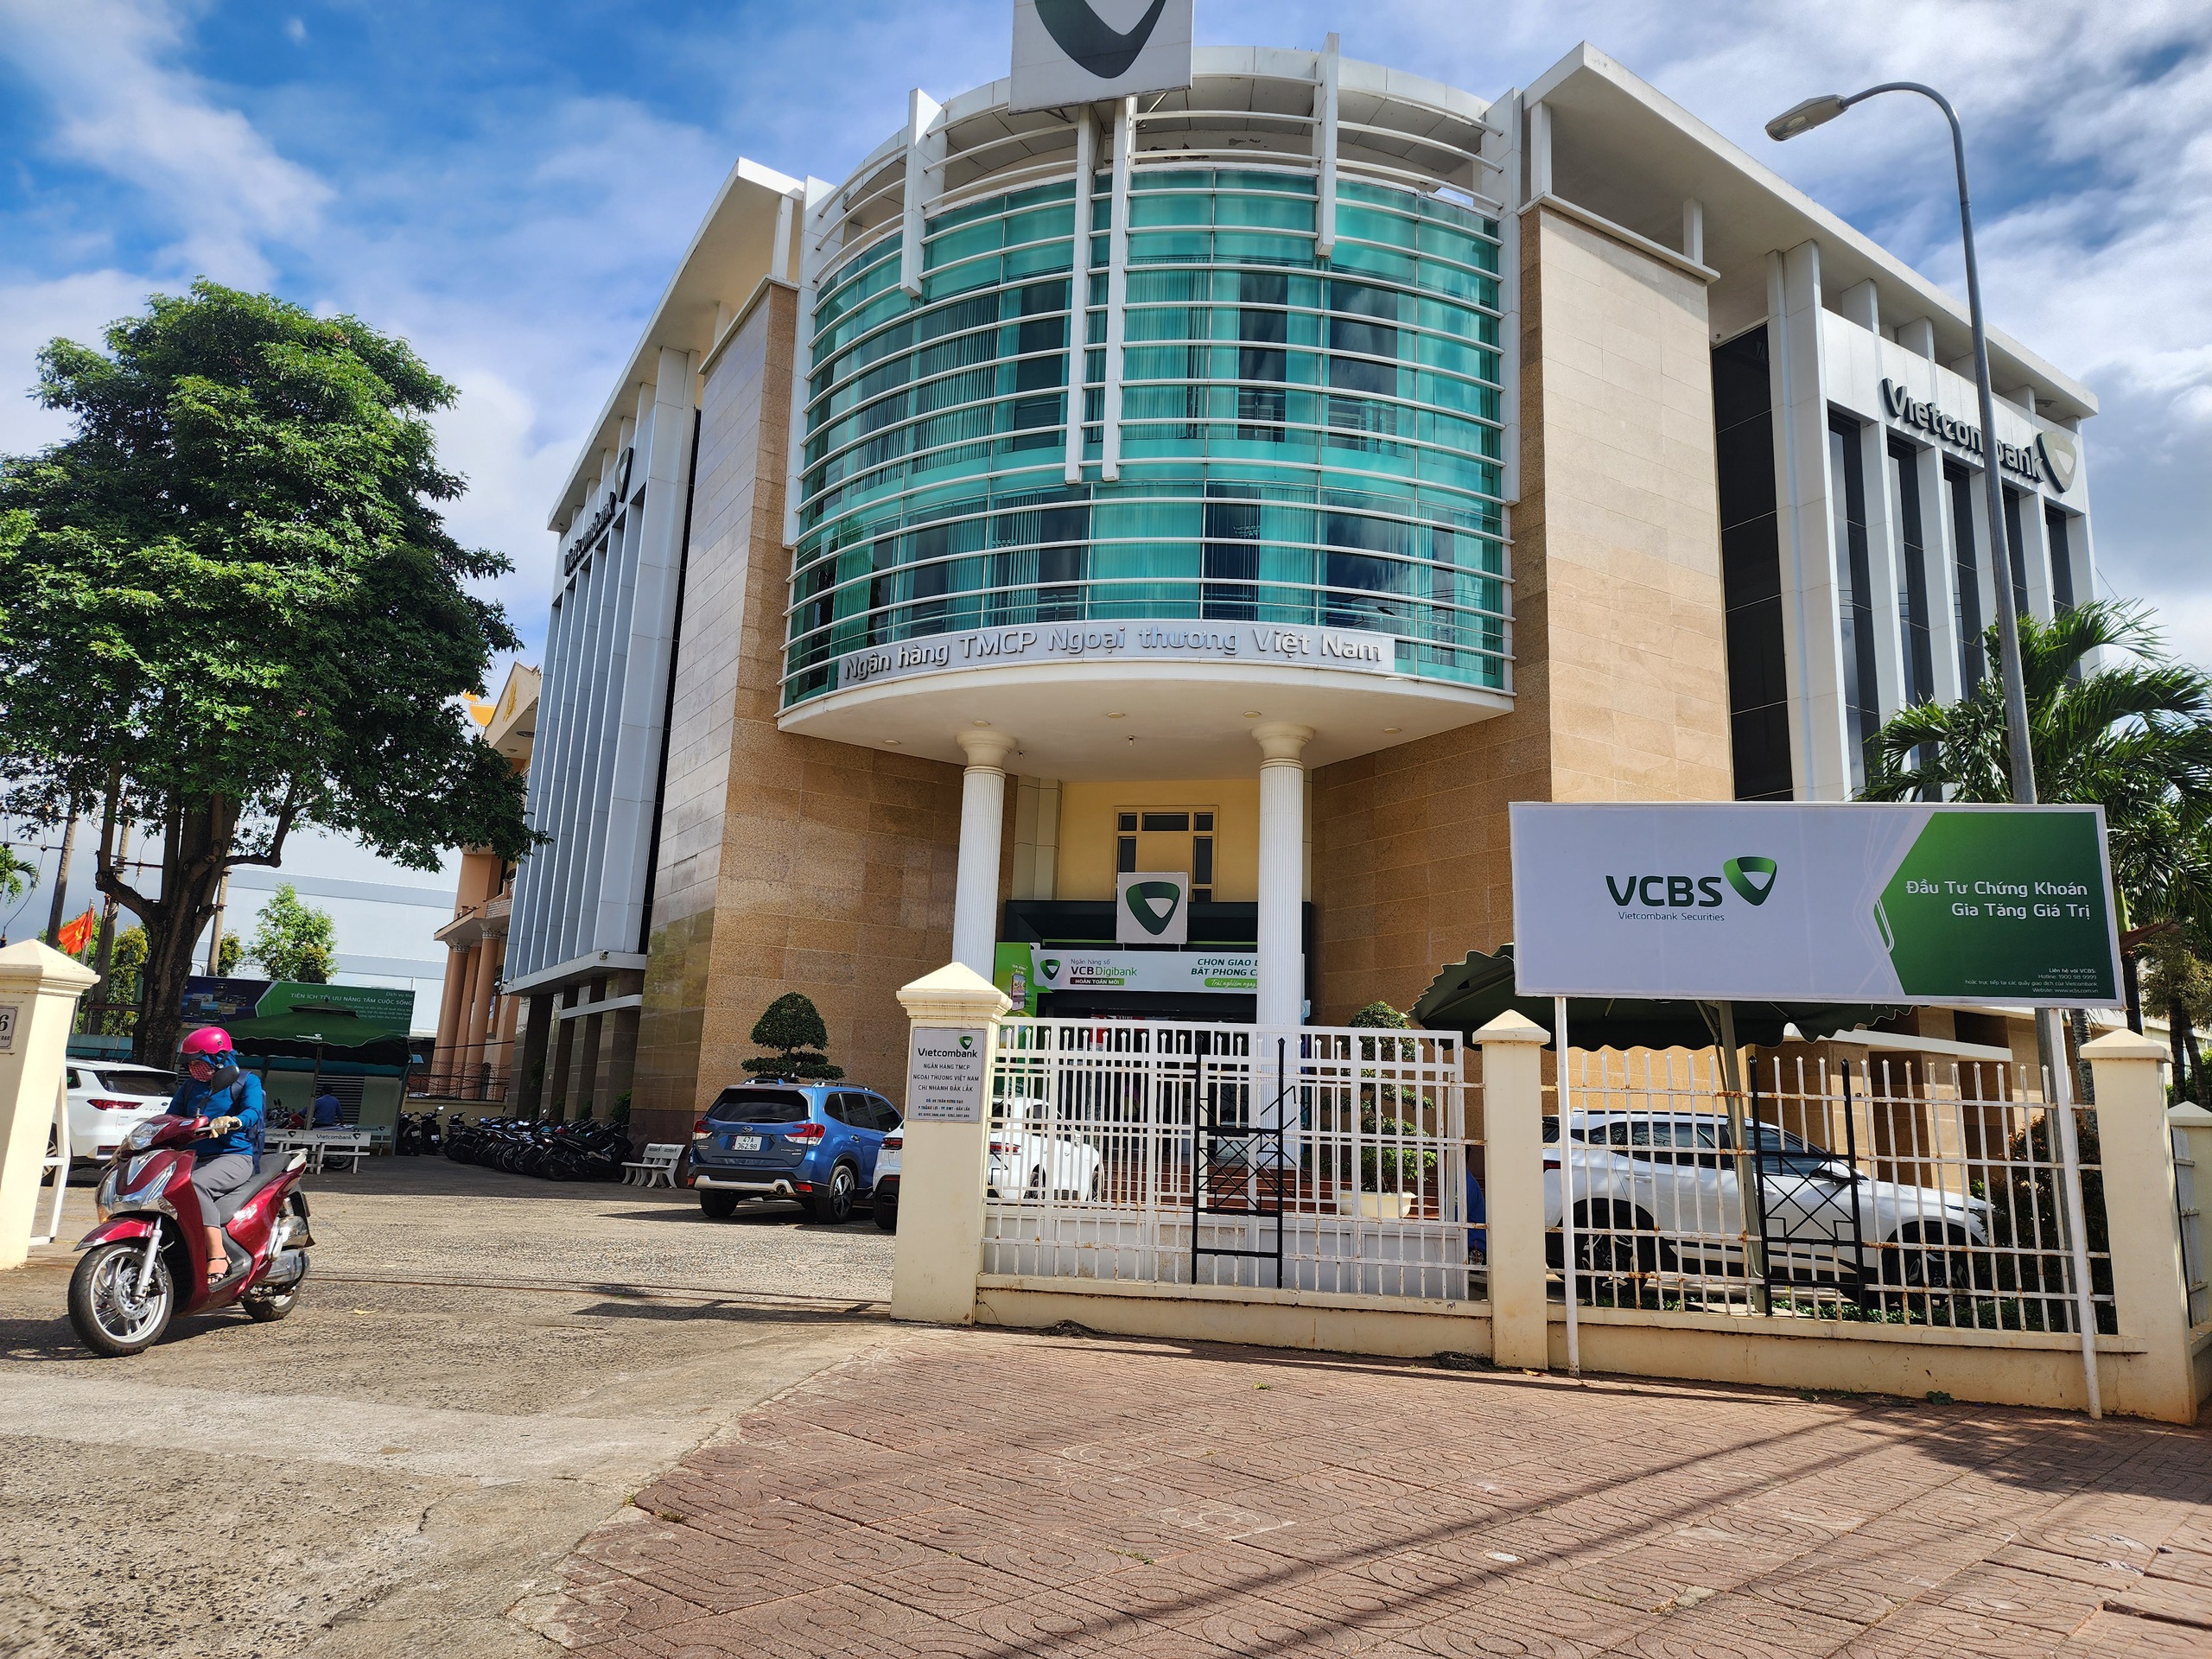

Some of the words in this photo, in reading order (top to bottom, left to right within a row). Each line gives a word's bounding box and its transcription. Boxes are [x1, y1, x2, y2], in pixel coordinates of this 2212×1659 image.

[844, 653, 892, 680] Ngân
[897, 644, 950, 669] hàng
[959, 629, 1037, 658] TMCP
[1047, 626, 1125, 654] Ngoại
[1139, 625, 1241, 655] thương
[1253, 628, 1311, 658] Việt
[1322, 633, 1383, 662] Nam
[1605, 875, 1723, 907] VCBS
[1905, 879, 1939, 894] Đầu
[1944, 880, 1968, 894] Tư
[1974, 880, 2028, 898] Chứng
[2034, 880, 2088, 895] Khoán
[1618, 912, 1678, 921] Vietcombank
[1681, 912, 1725, 922] Securities
[1952, 903, 1979, 917] Gia
[1984, 903, 2027, 919] Tăng
[2033, 903, 2061, 918] Giá
[2066, 904, 2090, 920] Trị
[1198, 958, 1224, 967] CHỌN
[1071, 966, 1094, 976] VCB
[1096, 966, 1138, 977] Digibank
[1191, 966, 1210, 976] BẬT
[918, 1047, 978, 1058] Vietcombank
